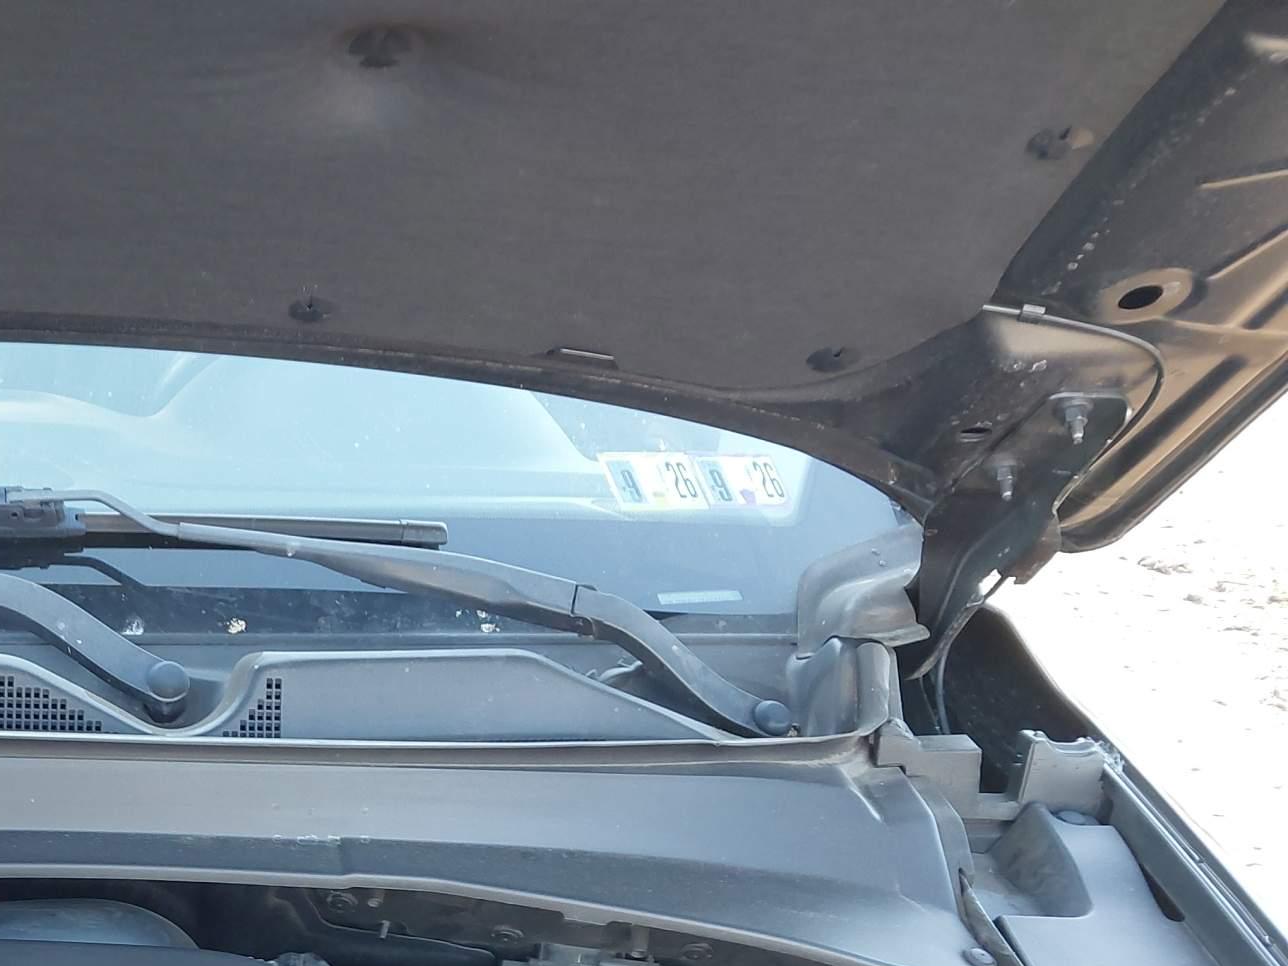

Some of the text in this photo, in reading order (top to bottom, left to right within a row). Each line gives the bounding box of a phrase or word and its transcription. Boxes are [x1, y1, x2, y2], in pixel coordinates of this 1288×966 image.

[665, 462, 697, 498] 26
[709, 461, 785, 502] 9 26
